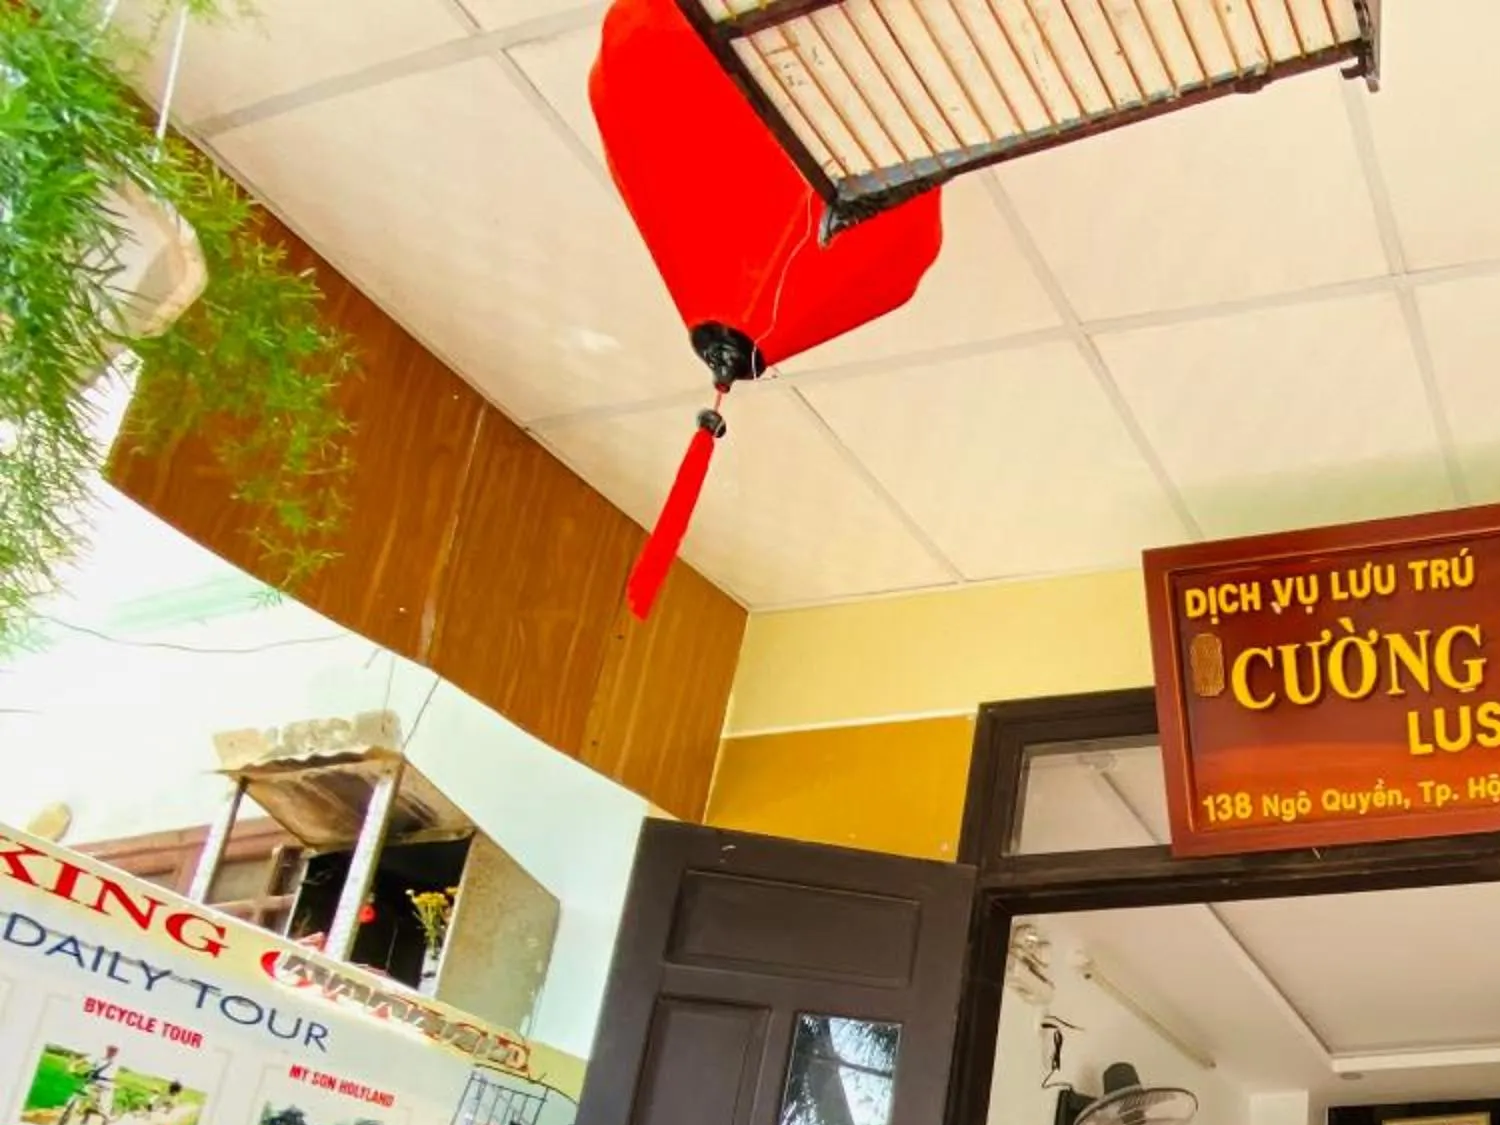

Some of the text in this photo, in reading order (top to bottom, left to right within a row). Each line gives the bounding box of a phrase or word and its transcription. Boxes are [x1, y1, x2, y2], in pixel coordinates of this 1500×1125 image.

[1185, 547, 1475, 624] DỊCH VỤ LƯU TRÚ
[1231, 617, 1487, 709] CƯỜNG
[1203, 792, 1253, 823] 138
[1262, 790, 1312, 822] Ngô
[1418, 781, 1459, 808] Tp.
[3, 912, 173, 992] DAILY
[192, 978, 330, 1053] TOUR
[83, 996, 204, 1049] BYCYCLE TOUR
